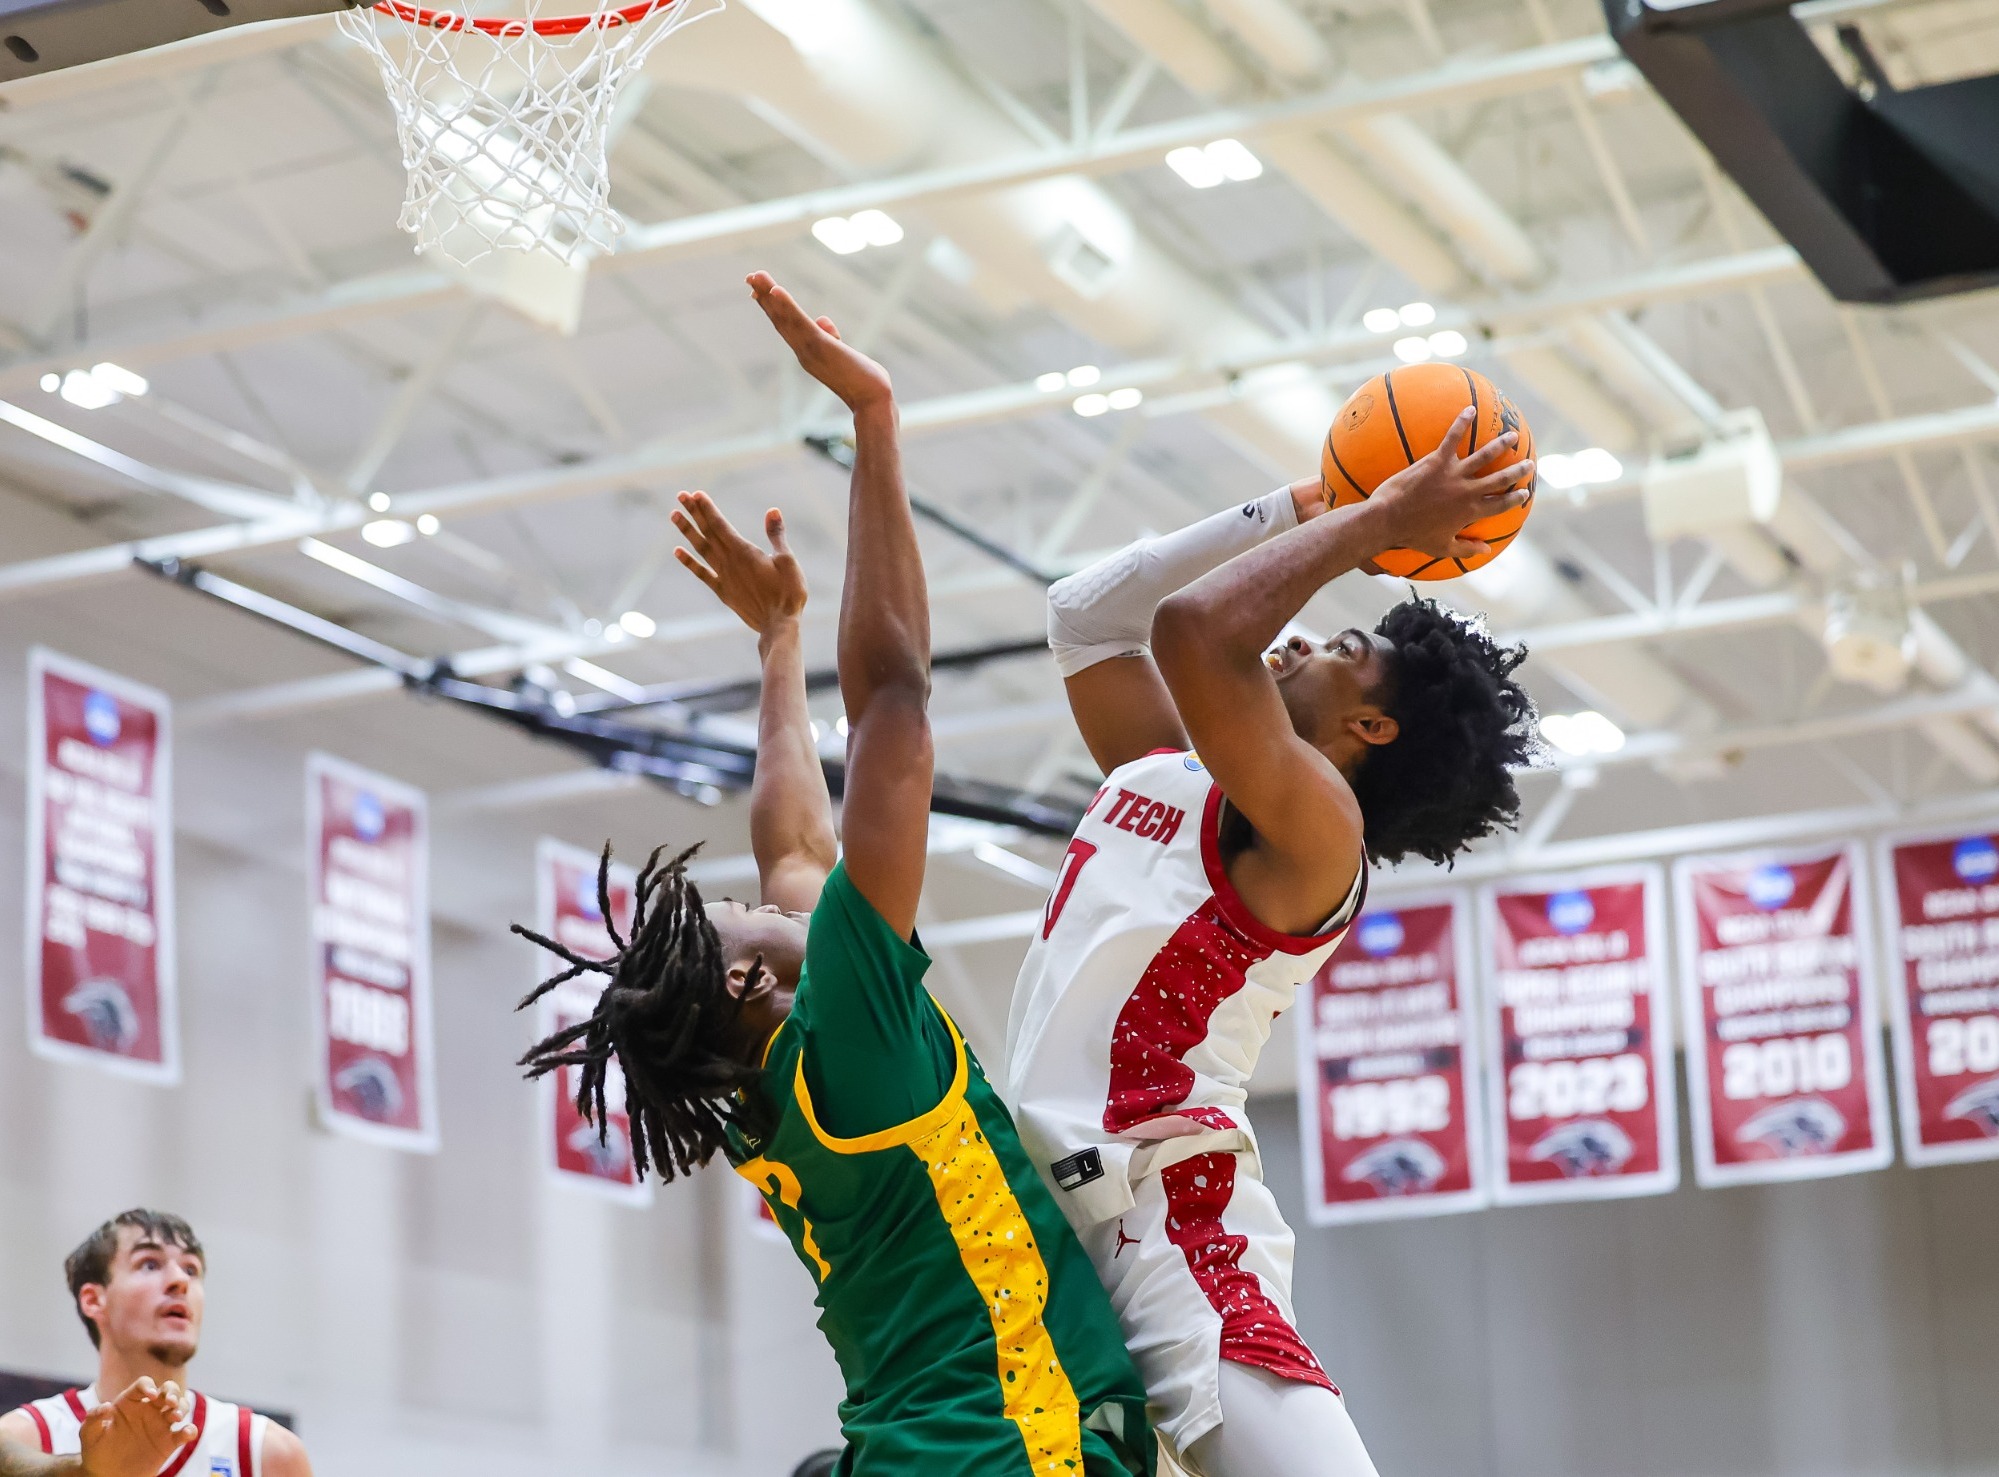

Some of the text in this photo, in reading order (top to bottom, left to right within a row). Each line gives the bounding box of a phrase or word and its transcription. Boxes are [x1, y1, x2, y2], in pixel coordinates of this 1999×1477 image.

[1103, 788, 1186, 846] TECH
[1508, 1053, 1648, 1121] 2023
[1722, 1032, 1850, 1100] 2010
[1083, 1159, 1093, 1172] L
